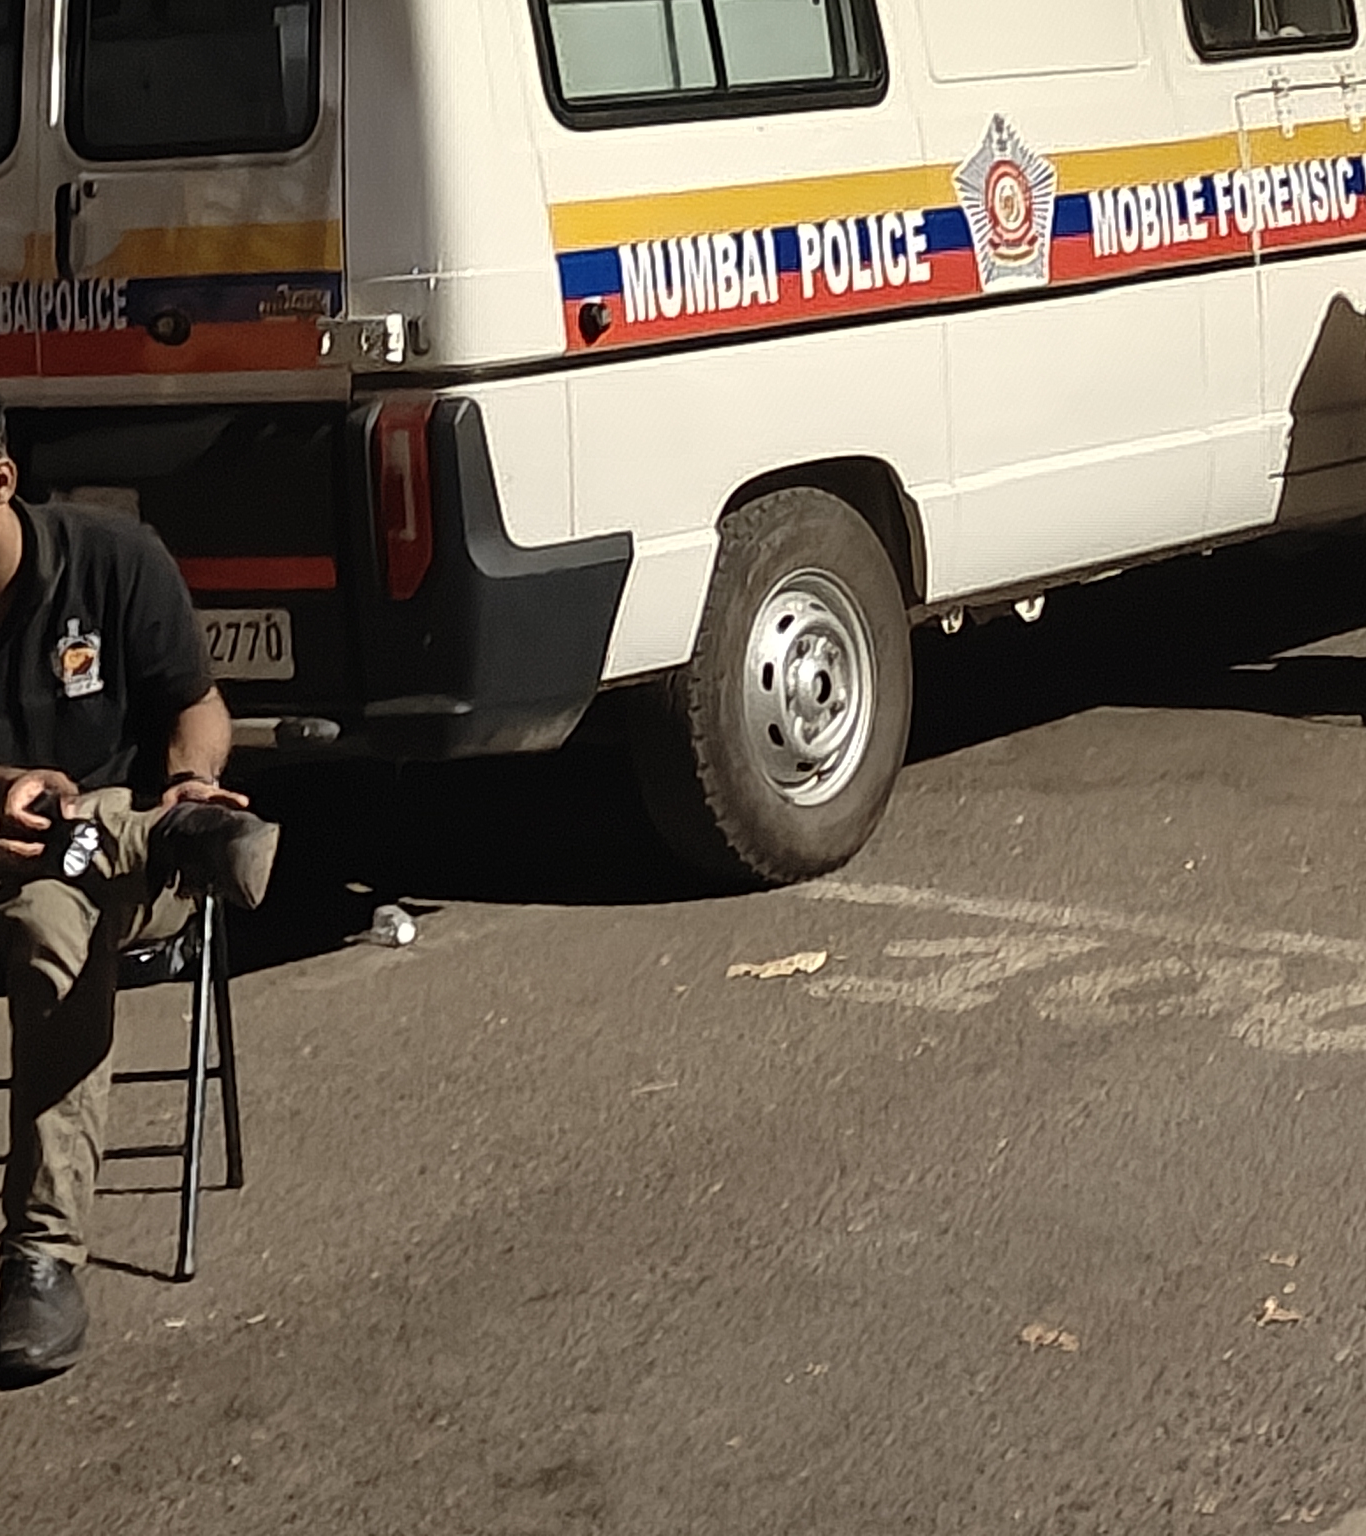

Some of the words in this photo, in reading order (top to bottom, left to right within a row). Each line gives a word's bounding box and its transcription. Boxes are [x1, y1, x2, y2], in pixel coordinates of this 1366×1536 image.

[618, 226, 779, 323] MUMBAI
[797, 212, 932, 296] POLICE
[1090, 174, 1212, 257] MOBILE
[1214, 158, 1357, 233] FORENSIC
[39, 277, 129, 331] POLICE
